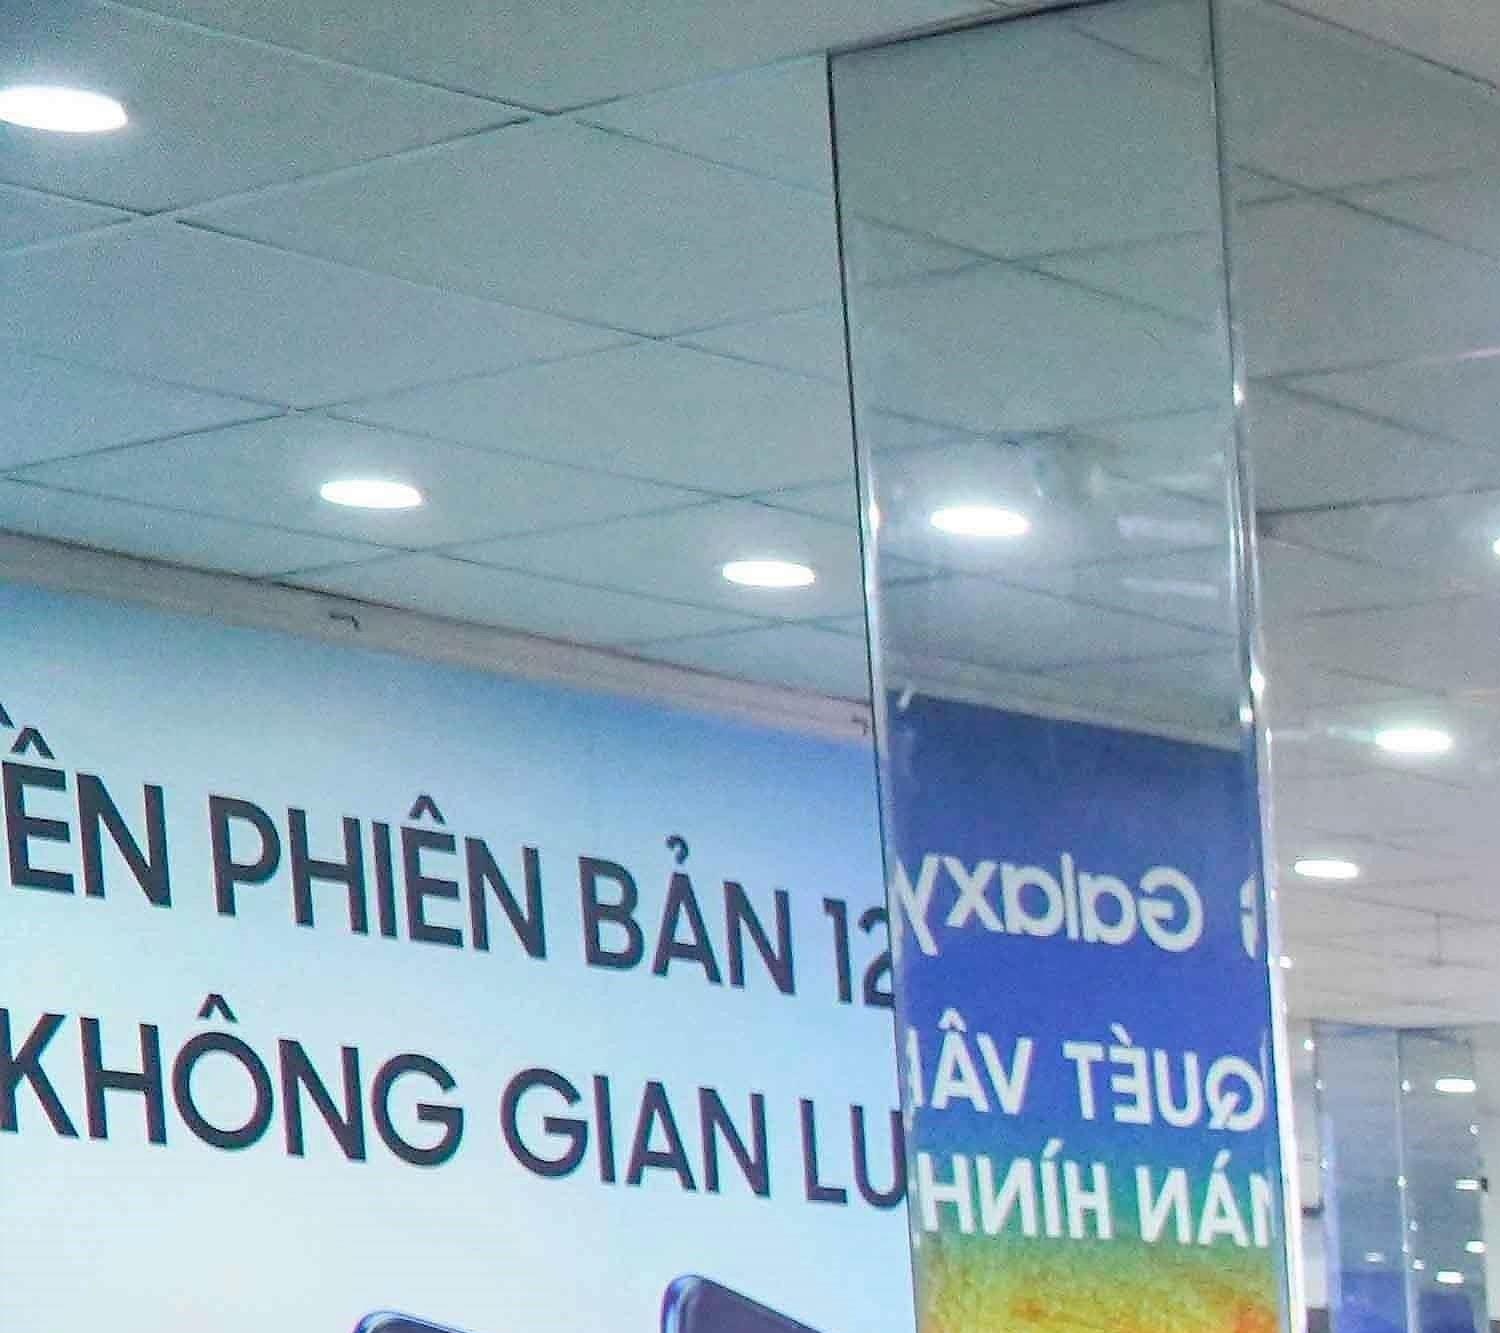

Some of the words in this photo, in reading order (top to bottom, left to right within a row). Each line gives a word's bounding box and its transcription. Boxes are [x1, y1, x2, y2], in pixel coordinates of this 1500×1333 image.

[208, 795, 547, 960] PHIÊN
[577, 834, 796, 996] BẢN
[0, 992, 465, 1168] KHÔNG
[500, 1067, 771, 1199] GIAN
